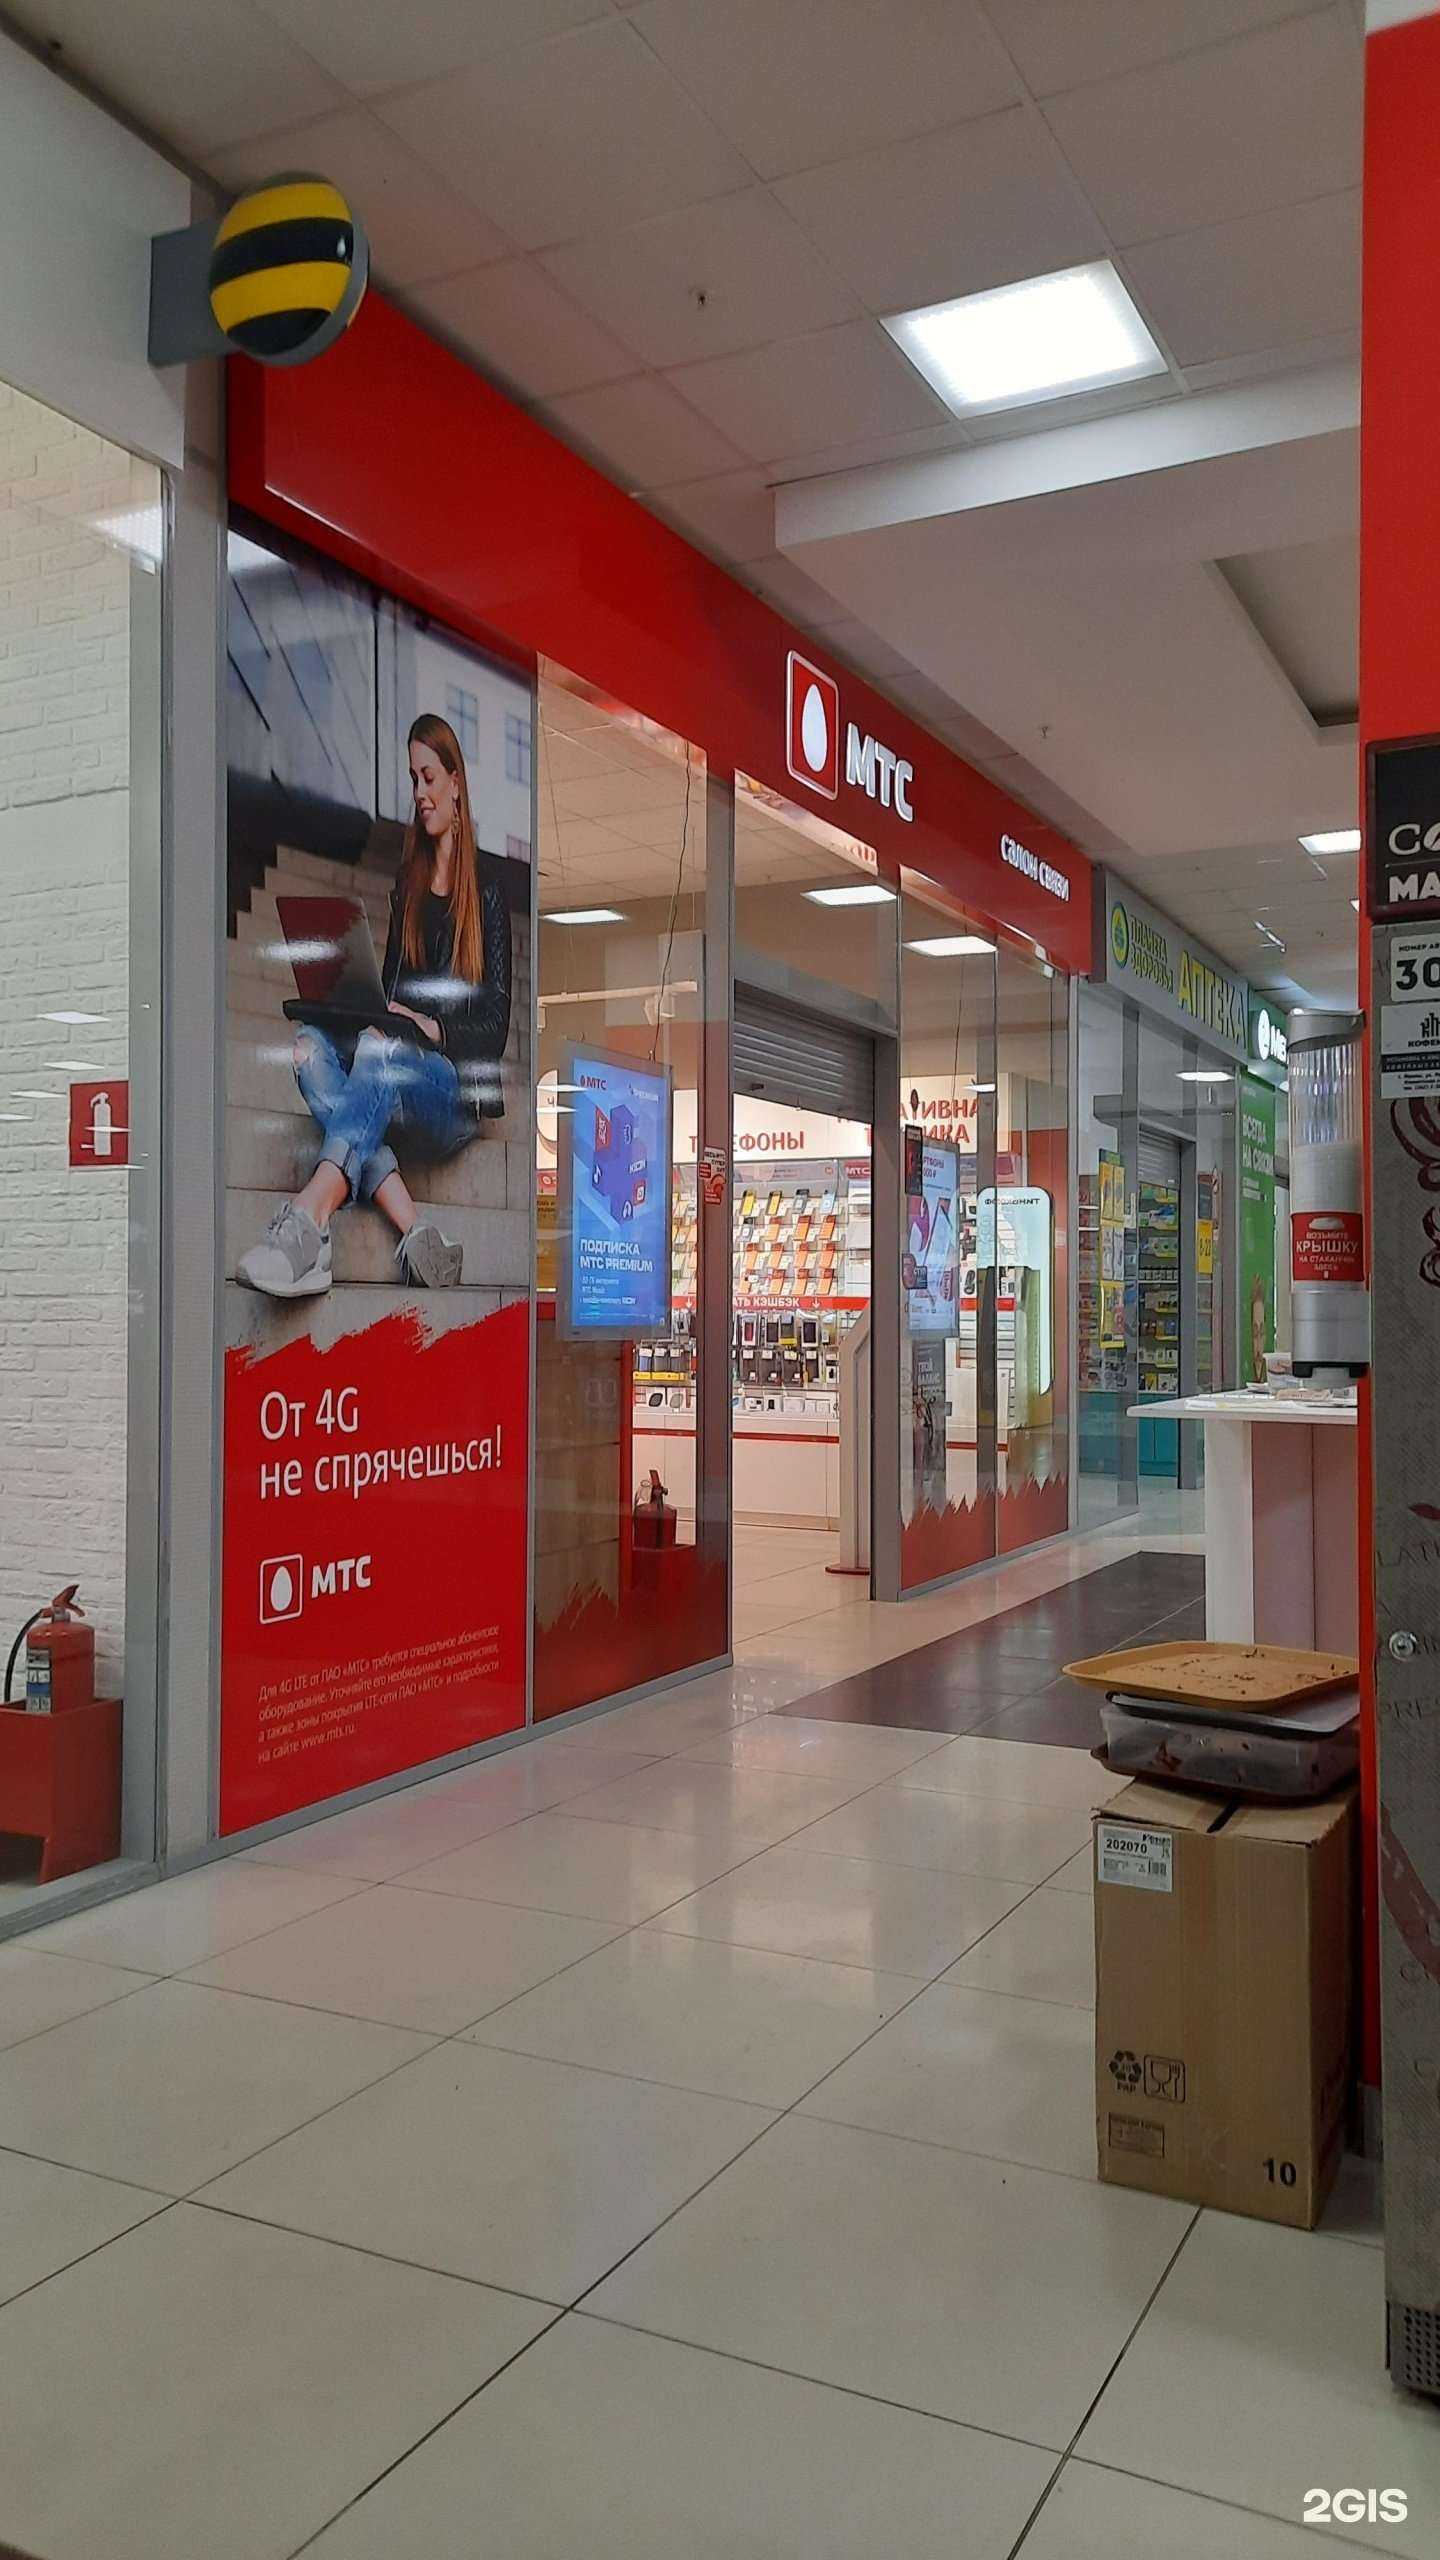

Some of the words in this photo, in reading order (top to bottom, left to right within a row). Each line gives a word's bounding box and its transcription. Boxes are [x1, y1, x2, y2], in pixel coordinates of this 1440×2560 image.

[845, 722, 913, 822] МТС
[1130, 914, 1168, 964] ПЛАНЕТА
[1178, 949, 1249, 1049] АПТЕКА
[580, 1238, 640, 1256] ПОДПИСКА
[1296, 1240, 1358, 1254] КРЫШКУ
[580, 1255, 604, 1270] МТС
[605, 1257, 653, 1272] PREMIUM
[752, 1297, 800, 1308] КЭШБЭК
[260, 1390, 305, 1441] От
[315, 1387, 359, 1435] 4G
[260, 1460, 302, 1499] не
[314, 1425, 502, 1500] спрячешься!
[311, 1555, 372, 1598] МТС
[258, 1686, 277, 1702] Для
[279, 1681, 291, 1696] 4G
[294, 1675, 309, 1691] LTE
[321, 1666, 341, 1685] ПАО
[400, 1682, 417, 1699] ПАО
[258, 1750, 270, 1764] на
[272, 1740, 299, 1759] сайте
[1106, 1838, 1148, 1854] 202070
[1262, 2157, 1297, 2186] 10
